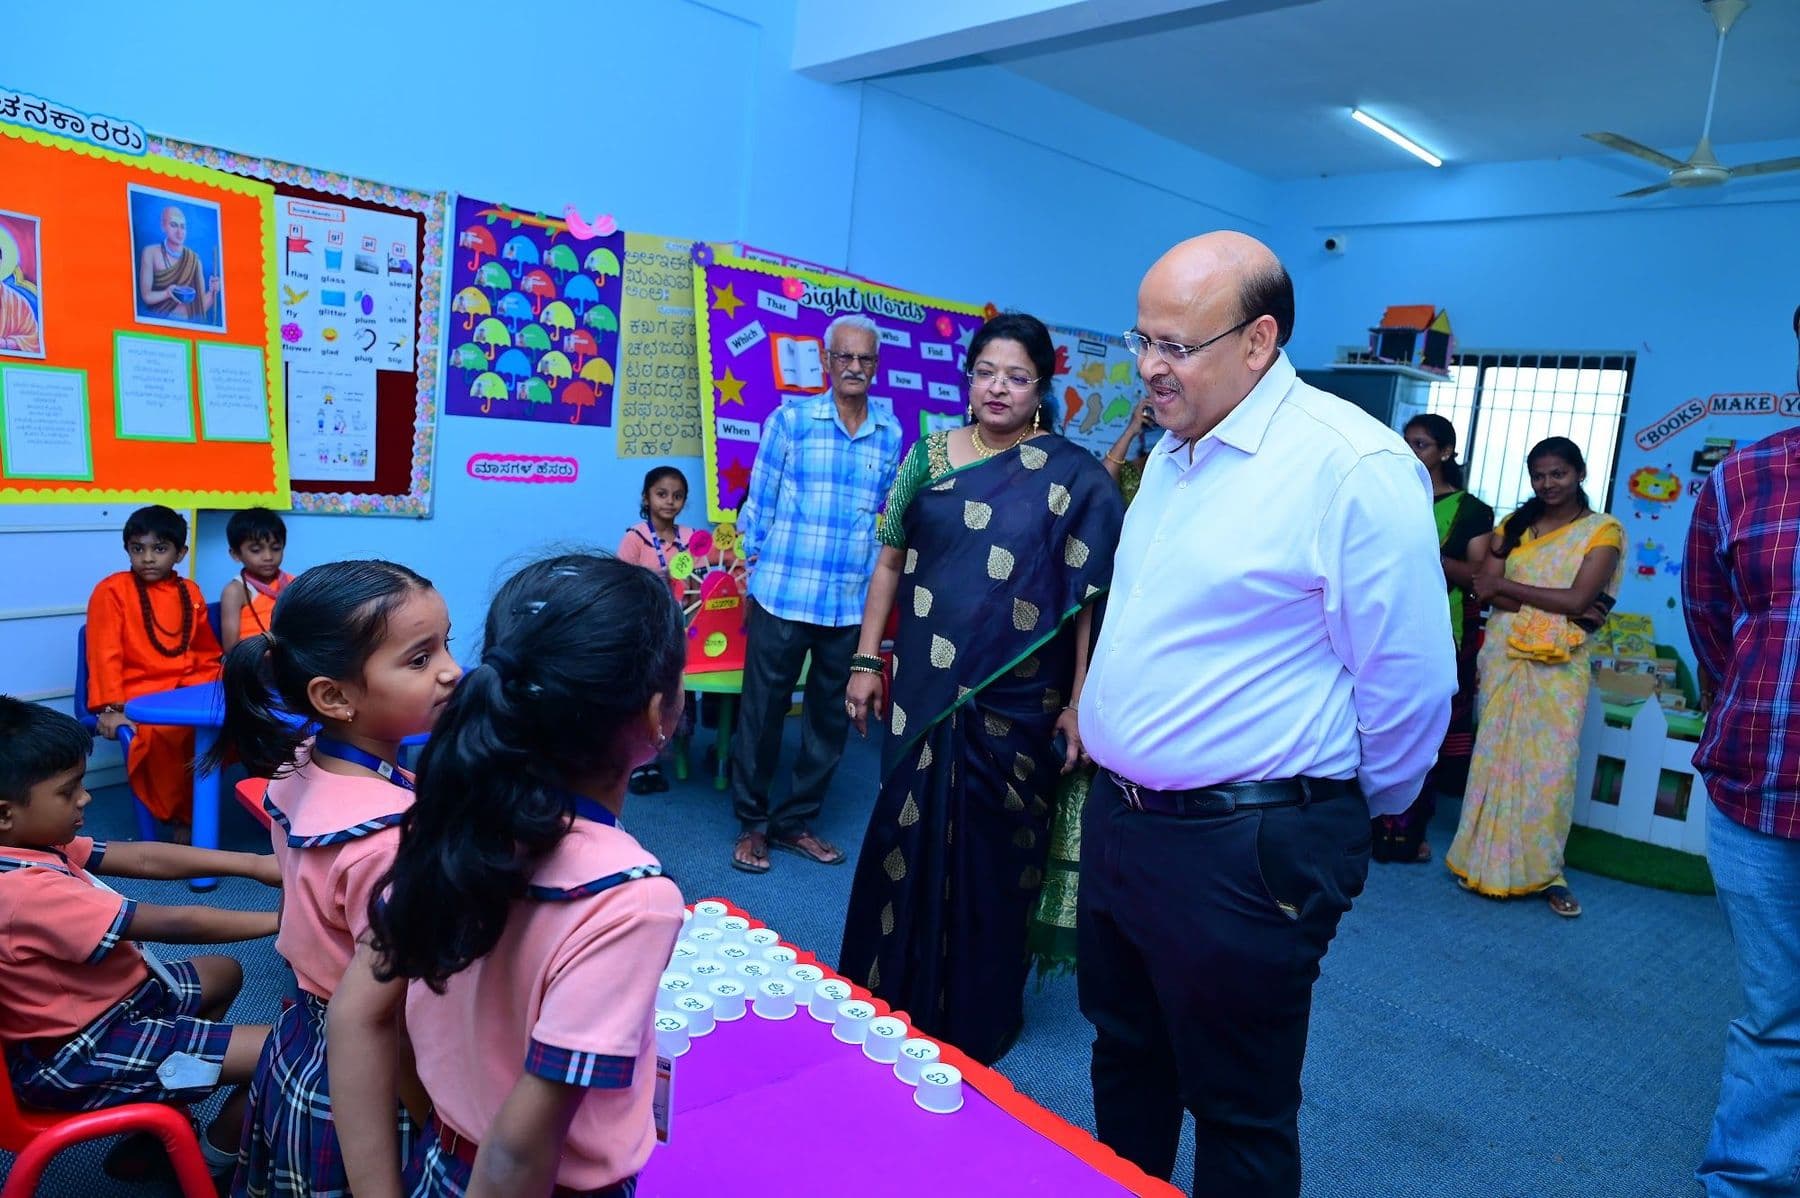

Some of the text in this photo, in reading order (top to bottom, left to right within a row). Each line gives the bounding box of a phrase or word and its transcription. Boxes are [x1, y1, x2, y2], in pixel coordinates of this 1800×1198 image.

[291, 270, 309, 280] flag
[766, 297, 787, 311] That
[801, 281, 924, 320] Sight Words
[286, 309, 298, 319] fly
[318, 308, 347, 318] glitter
[355, 317, 376, 325] plum
[732, 330, 758, 349] Which
[928, 346, 944, 356] Find
[354, 354, 374, 363] plug
[1713, 397, 1771, 411] MAKE
[722, 423, 750, 437] When
